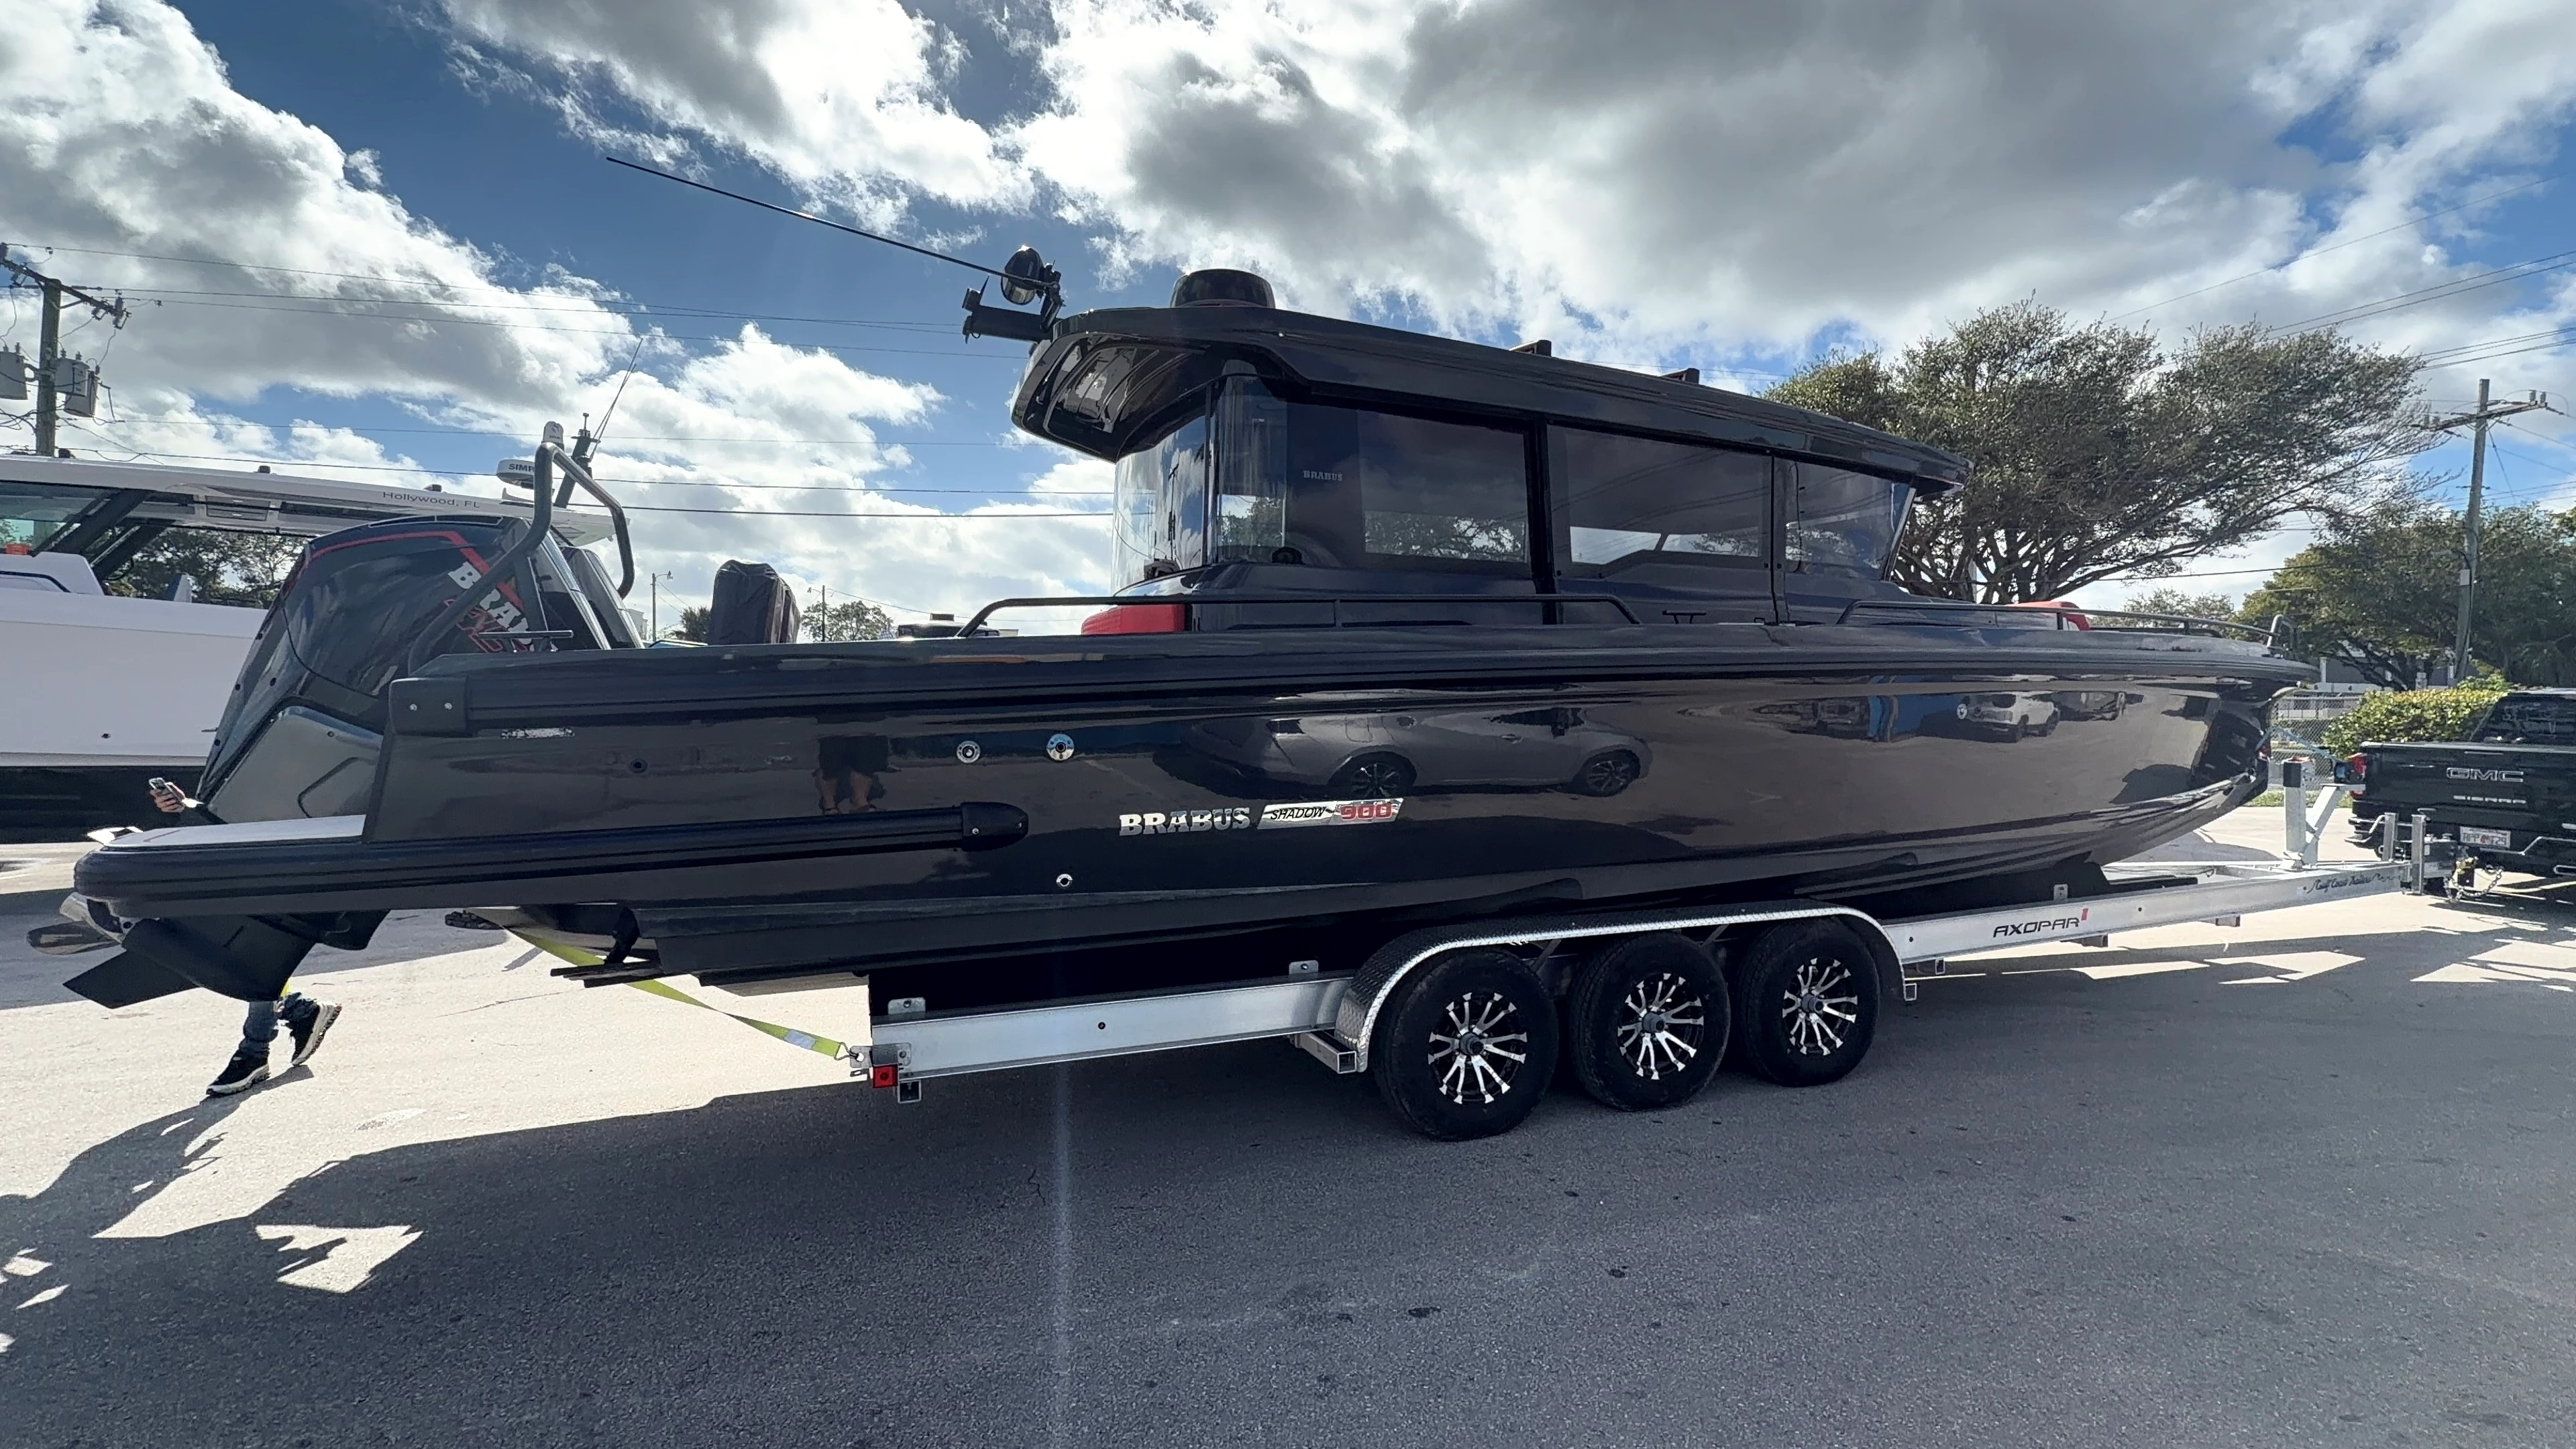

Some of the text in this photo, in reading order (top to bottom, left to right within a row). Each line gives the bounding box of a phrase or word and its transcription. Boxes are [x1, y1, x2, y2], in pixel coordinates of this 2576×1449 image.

[508, 463, 535, 472] SIMR
[1303, 470, 1344, 482] BRABUS
[464, 500, 480, 508] FL
[2446, 767, 2524, 783] GMC
[1119, 804, 1393, 836] BRABUS SHADOW 900
[1993, 917, 2080, 938] AXOPAR
